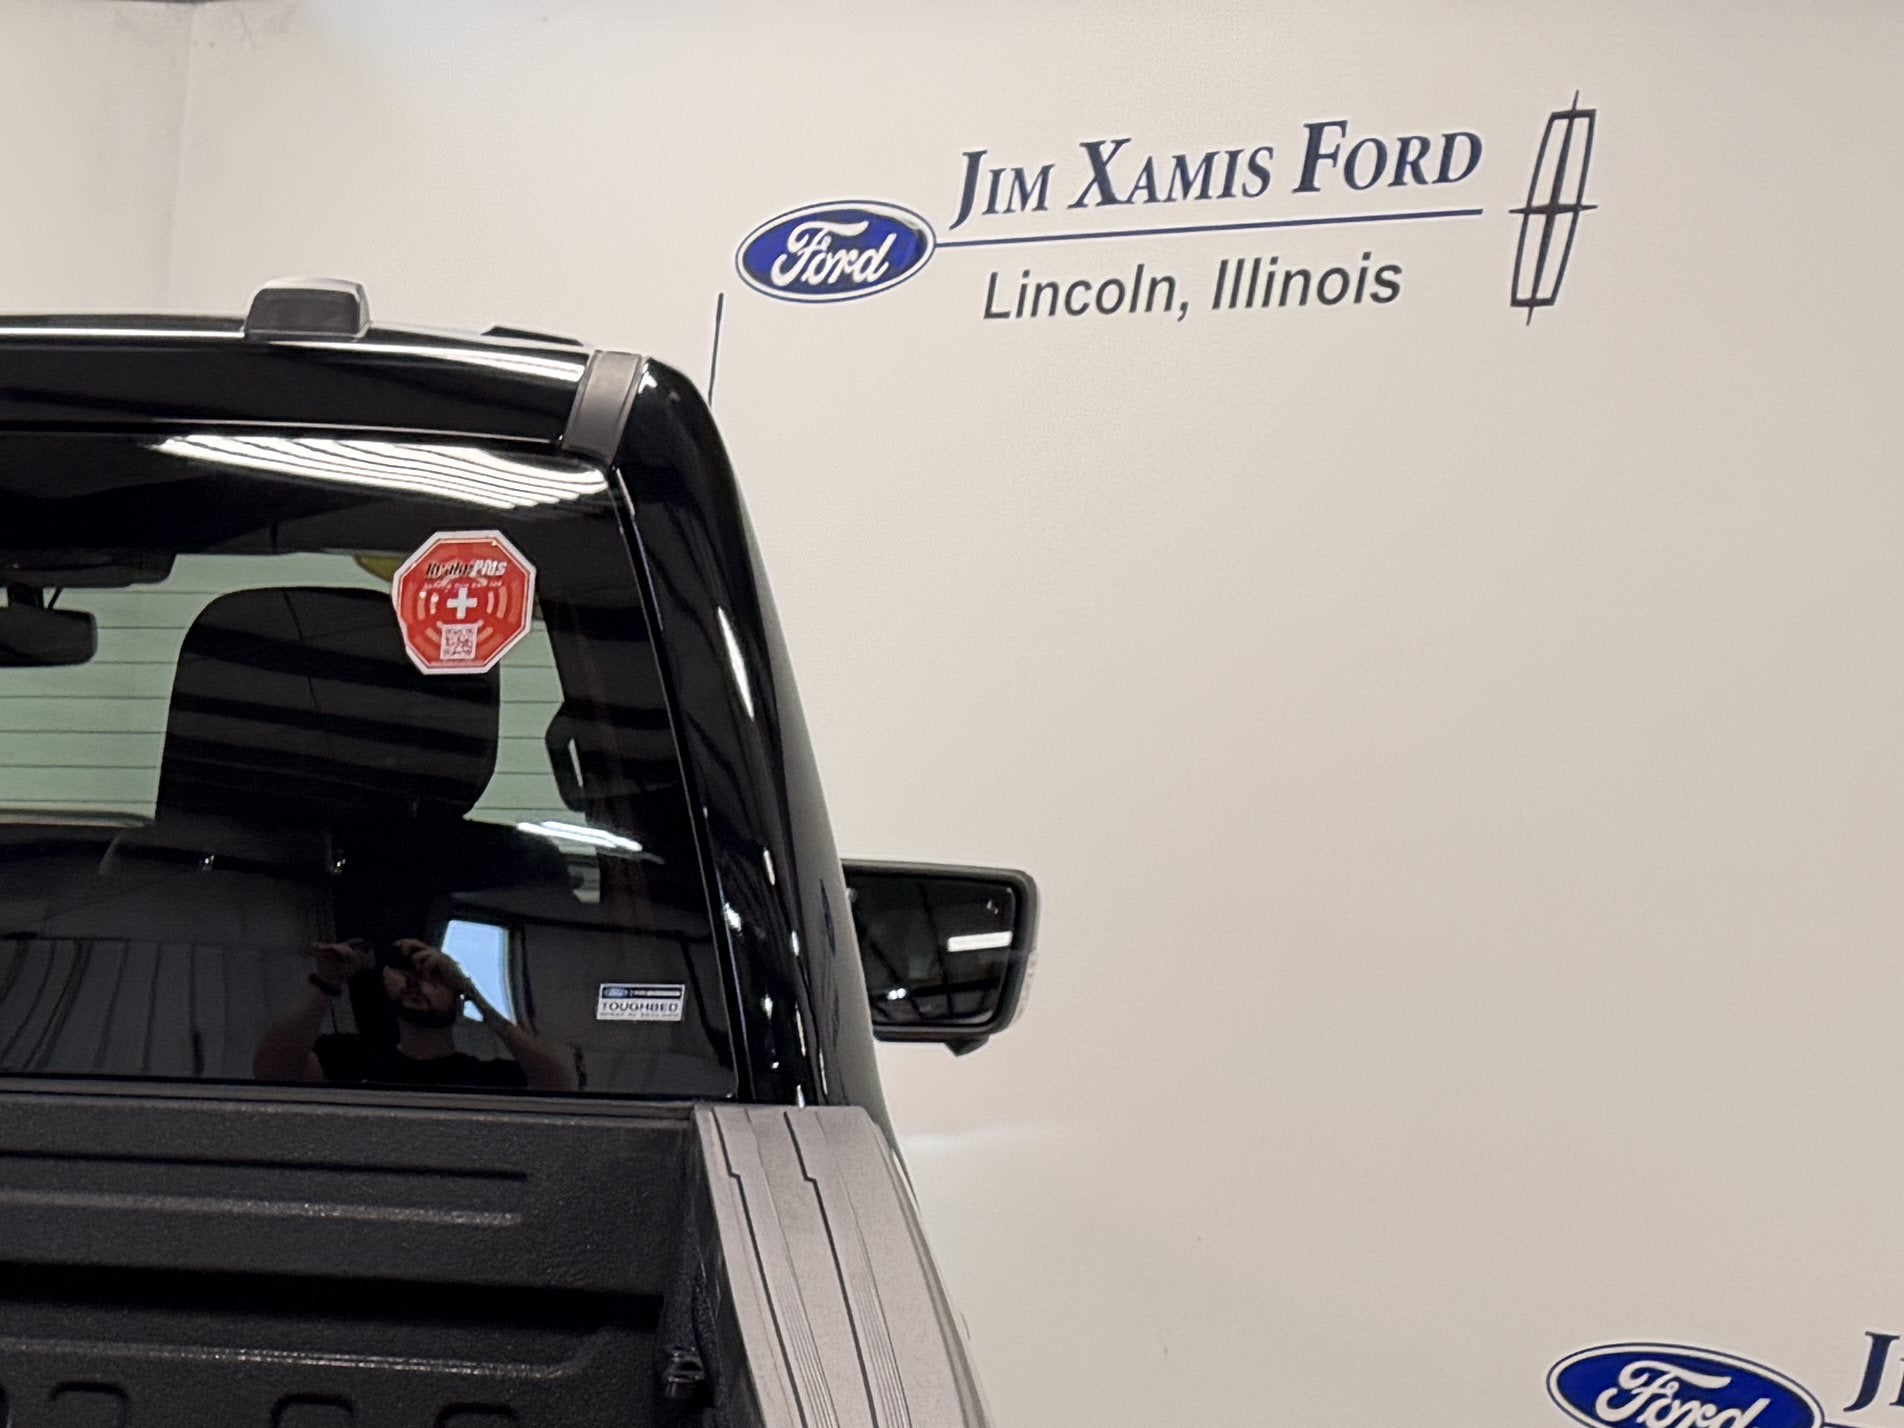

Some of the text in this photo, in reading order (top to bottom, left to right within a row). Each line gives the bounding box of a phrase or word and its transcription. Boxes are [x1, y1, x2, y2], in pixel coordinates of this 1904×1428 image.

[948, 119, 1483, 231] JIM XAMIS FORD
[770, 220, 897, 287] Ford
[982, 250, 1403, 323] Lincoln, Illinois
